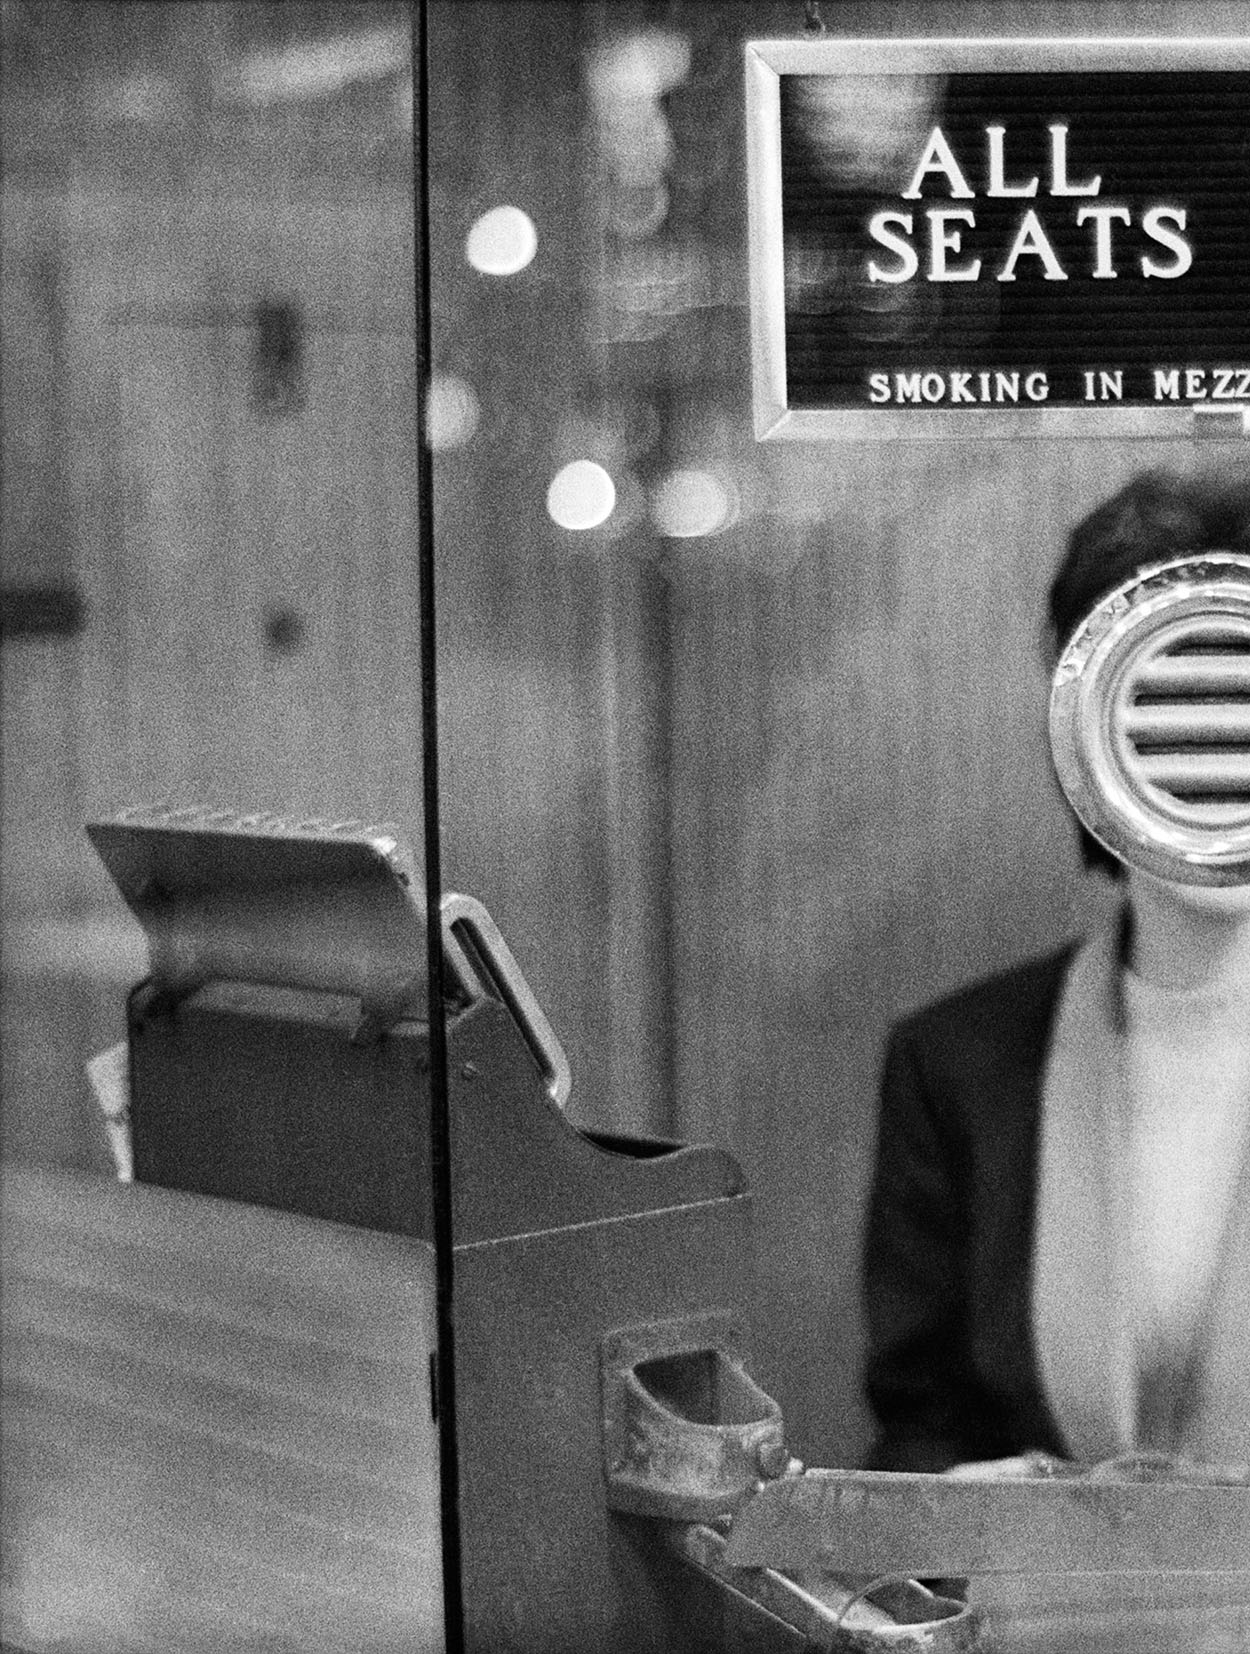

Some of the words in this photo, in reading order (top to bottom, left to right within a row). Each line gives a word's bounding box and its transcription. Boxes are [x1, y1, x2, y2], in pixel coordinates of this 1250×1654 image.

[901, 124, 1103, 199] ALL
[866, 206, 1195, 284] SEATS
[867, 370, 1051, 405] SMOKING
[1083, 370, 1124, 402] IN
